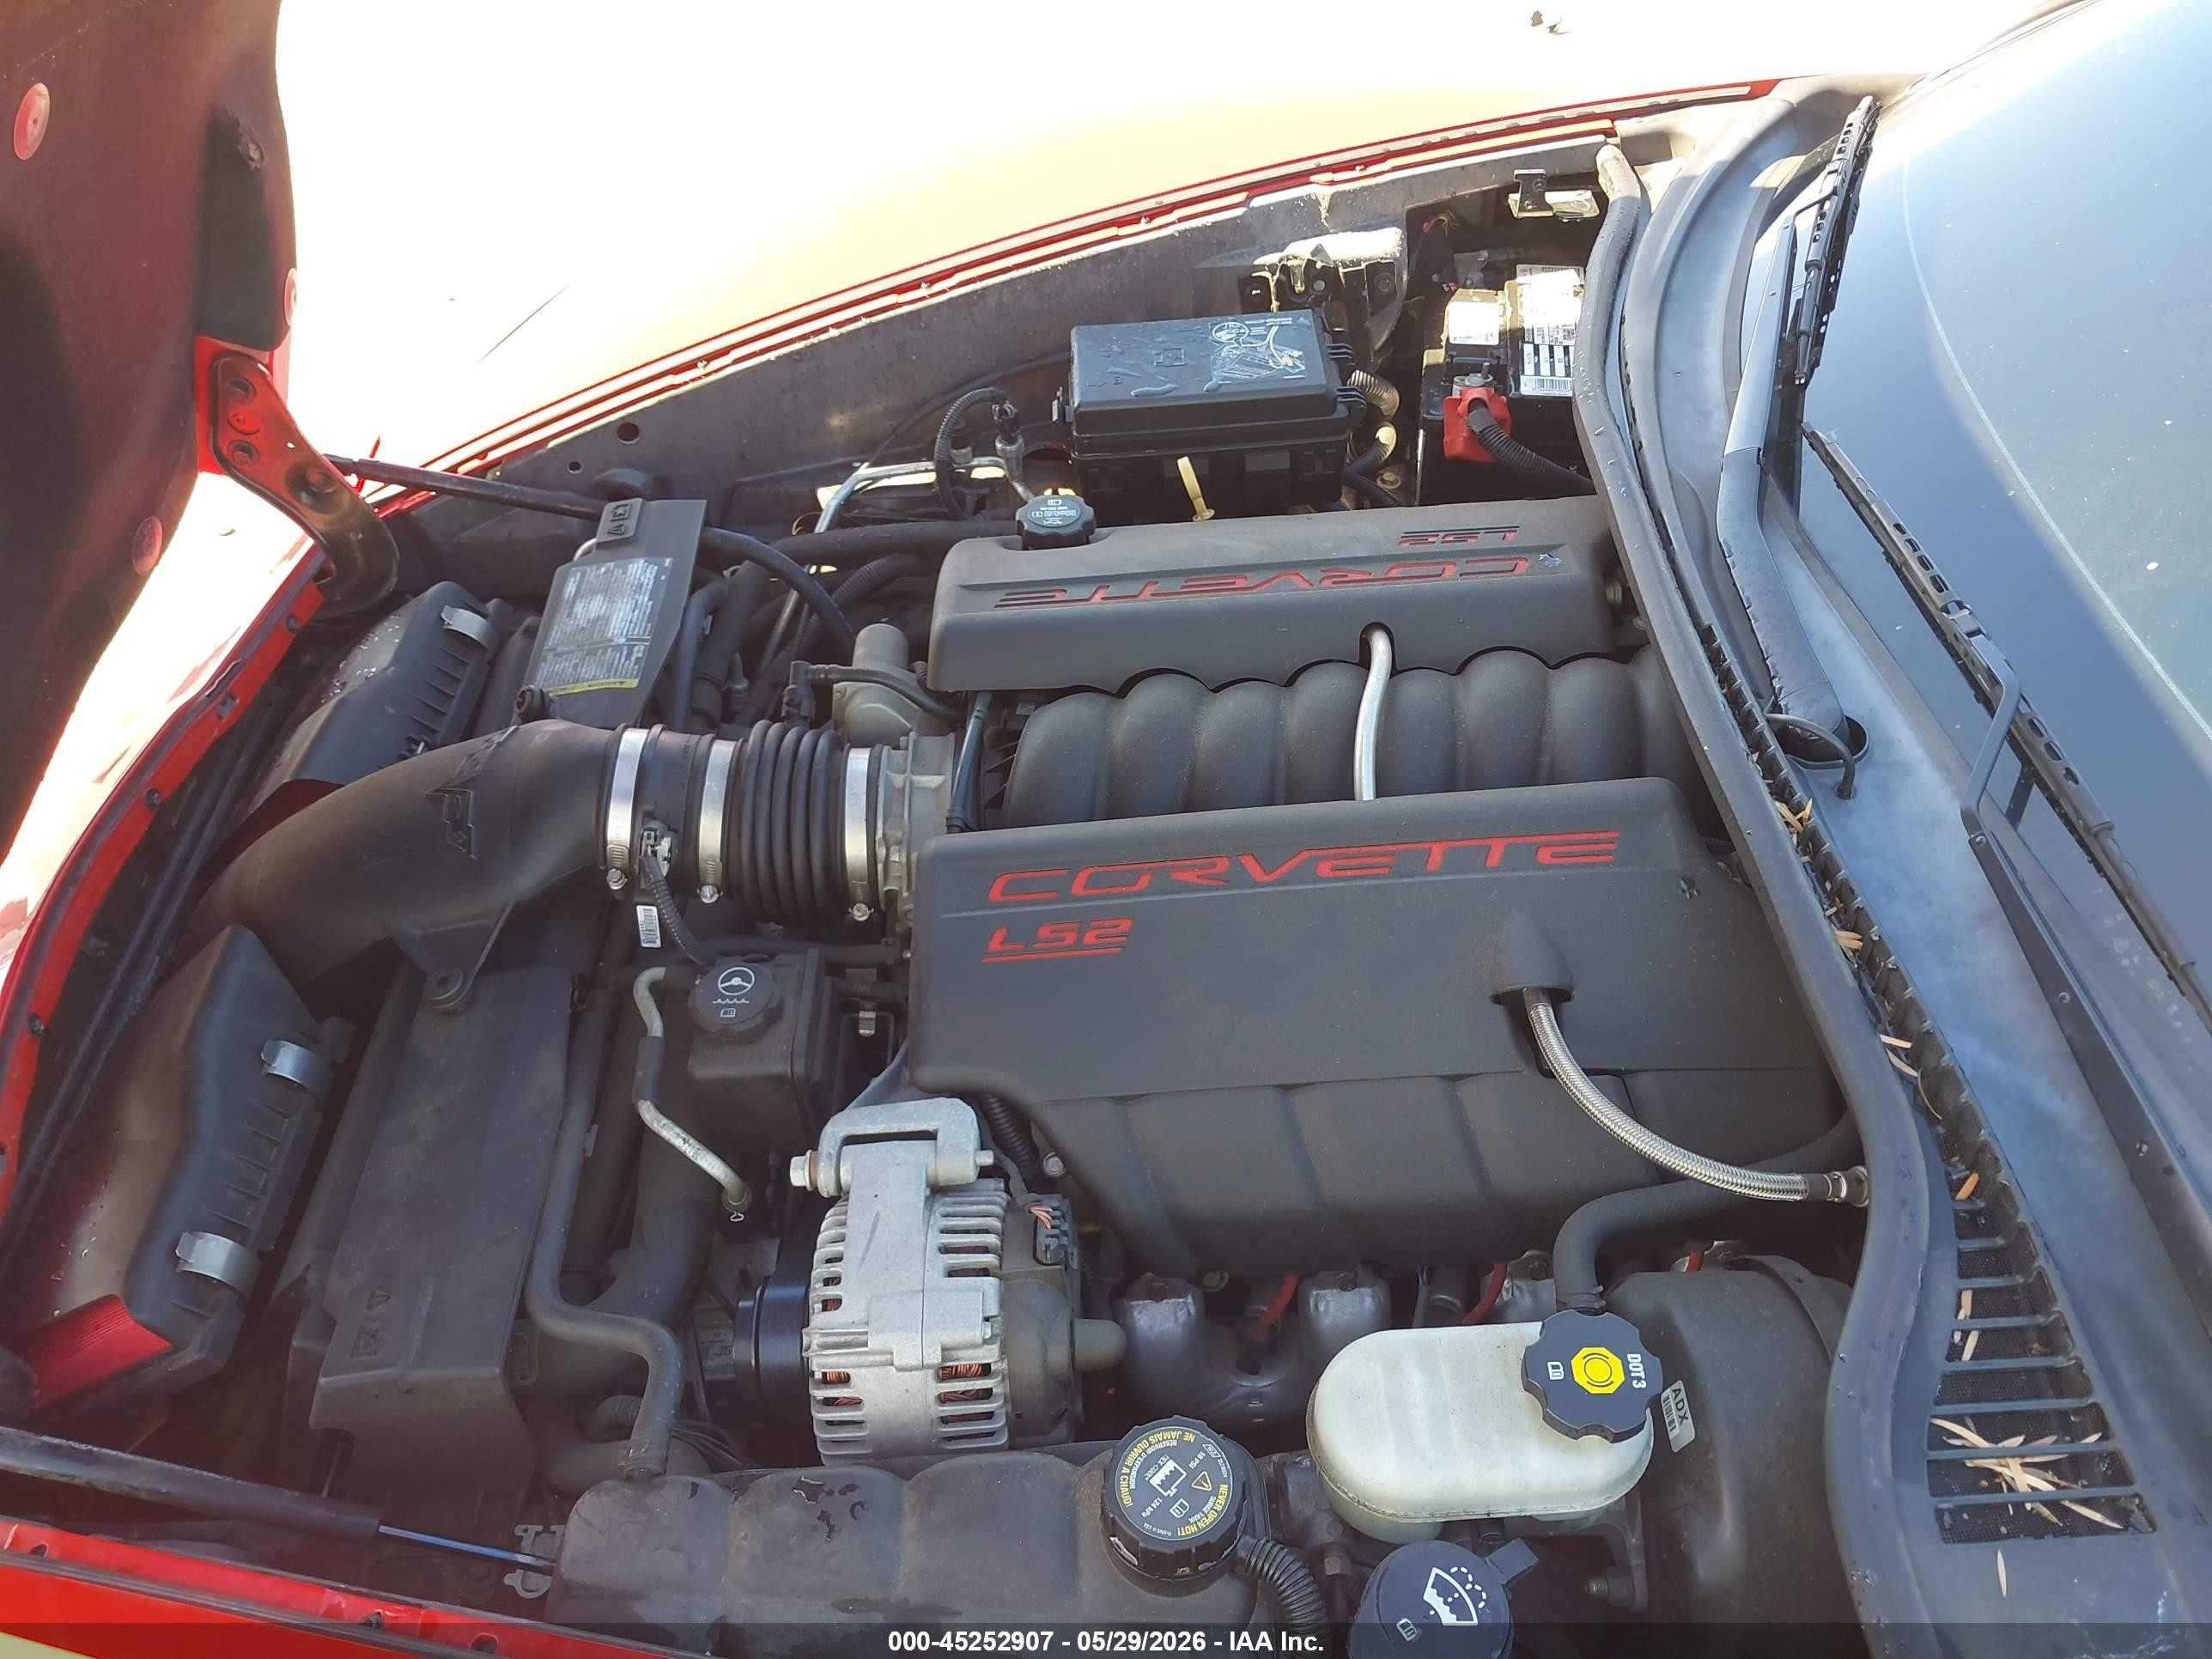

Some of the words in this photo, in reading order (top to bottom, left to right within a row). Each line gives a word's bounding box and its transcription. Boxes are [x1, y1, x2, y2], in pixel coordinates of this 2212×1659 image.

[1397, 526, 1521, 547] LS2
[994, 556, 1531, 609] CORVETTE
[988, 830, 1620, 903] CORVETTE
[984, 915, 1135, 953] LS2
[1626, 1353, 1646, 1379] DOT
[1632, 1379, 1647, 1389] 3
[1672, 1388, 1689, 1425] ADX
[1148, 1430, 1182, 1444] JAMAIS
[1182, 1431, 1196, 1443] NE
[1124, 1439, 1150, 1467] OUVRIR
[1197, 1450, 1206, 1460] 18
[1188, 1457, 1200, 1469] PSI
[1119, 1475, 1133, 1509] CHAUD!
[1212, 1484, 1229, 1511] NEVER
[1140, 1506, 1154, 1518] kPa
[1151, 1497, 1163, 1509] 124
[1202, 1495, 1217, 1514] SURGE
[1188, 1511, 1204, 1523] TANK
[1197, 1510, 1218, 1528] OPEN
[1177, 1524, 1198, 1536] HOT!
